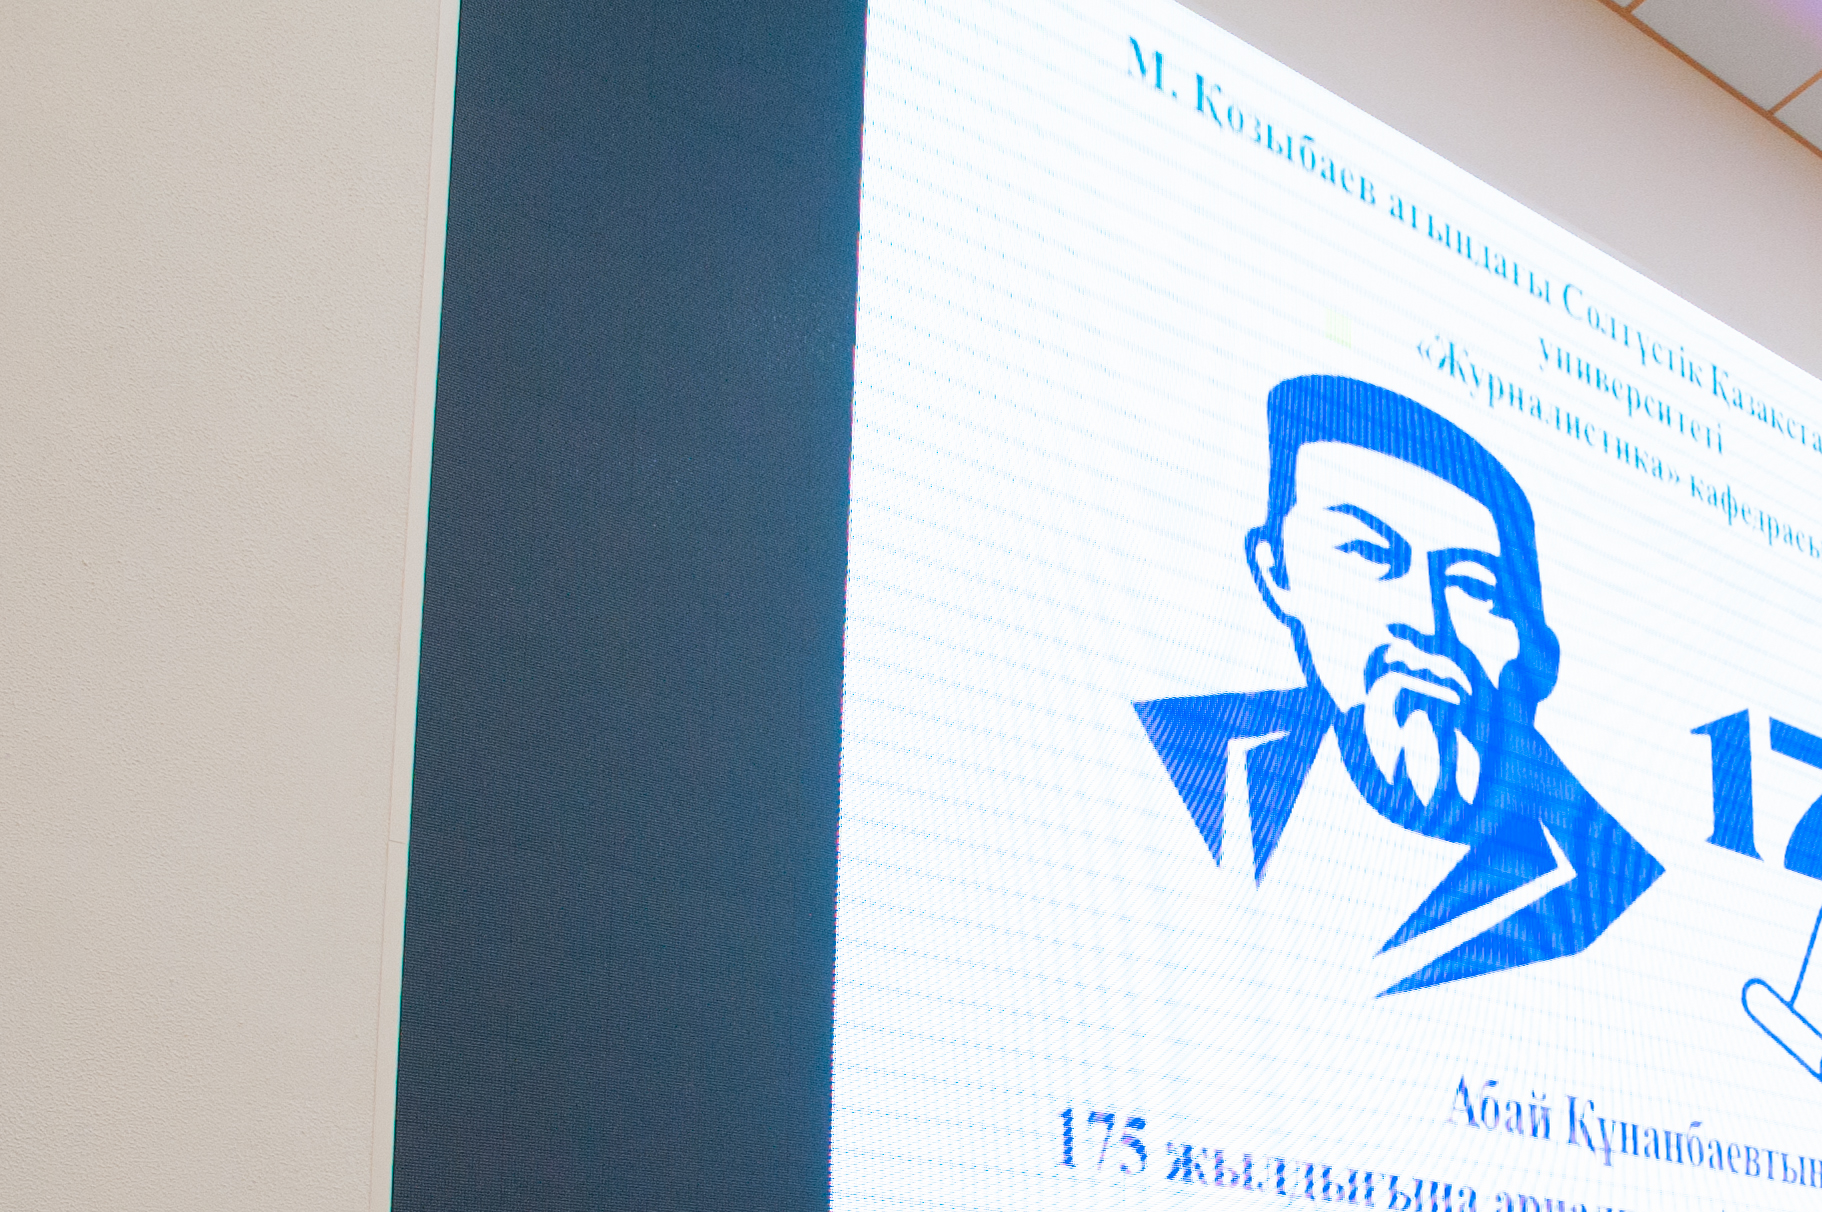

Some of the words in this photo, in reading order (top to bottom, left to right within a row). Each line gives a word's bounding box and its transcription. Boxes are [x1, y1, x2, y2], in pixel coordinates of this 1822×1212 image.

[1389, 191, 1551, 305] атындағы
[1562, 283, 1702, 389] Солтүстік
[1416, 334, 1680, 486] «Журналистика»
[1538, 336, 1723, 455] университеті
[1060, 1106, 1148, 1175] 175
[1449, 1074, 1551, 1141] Абай
